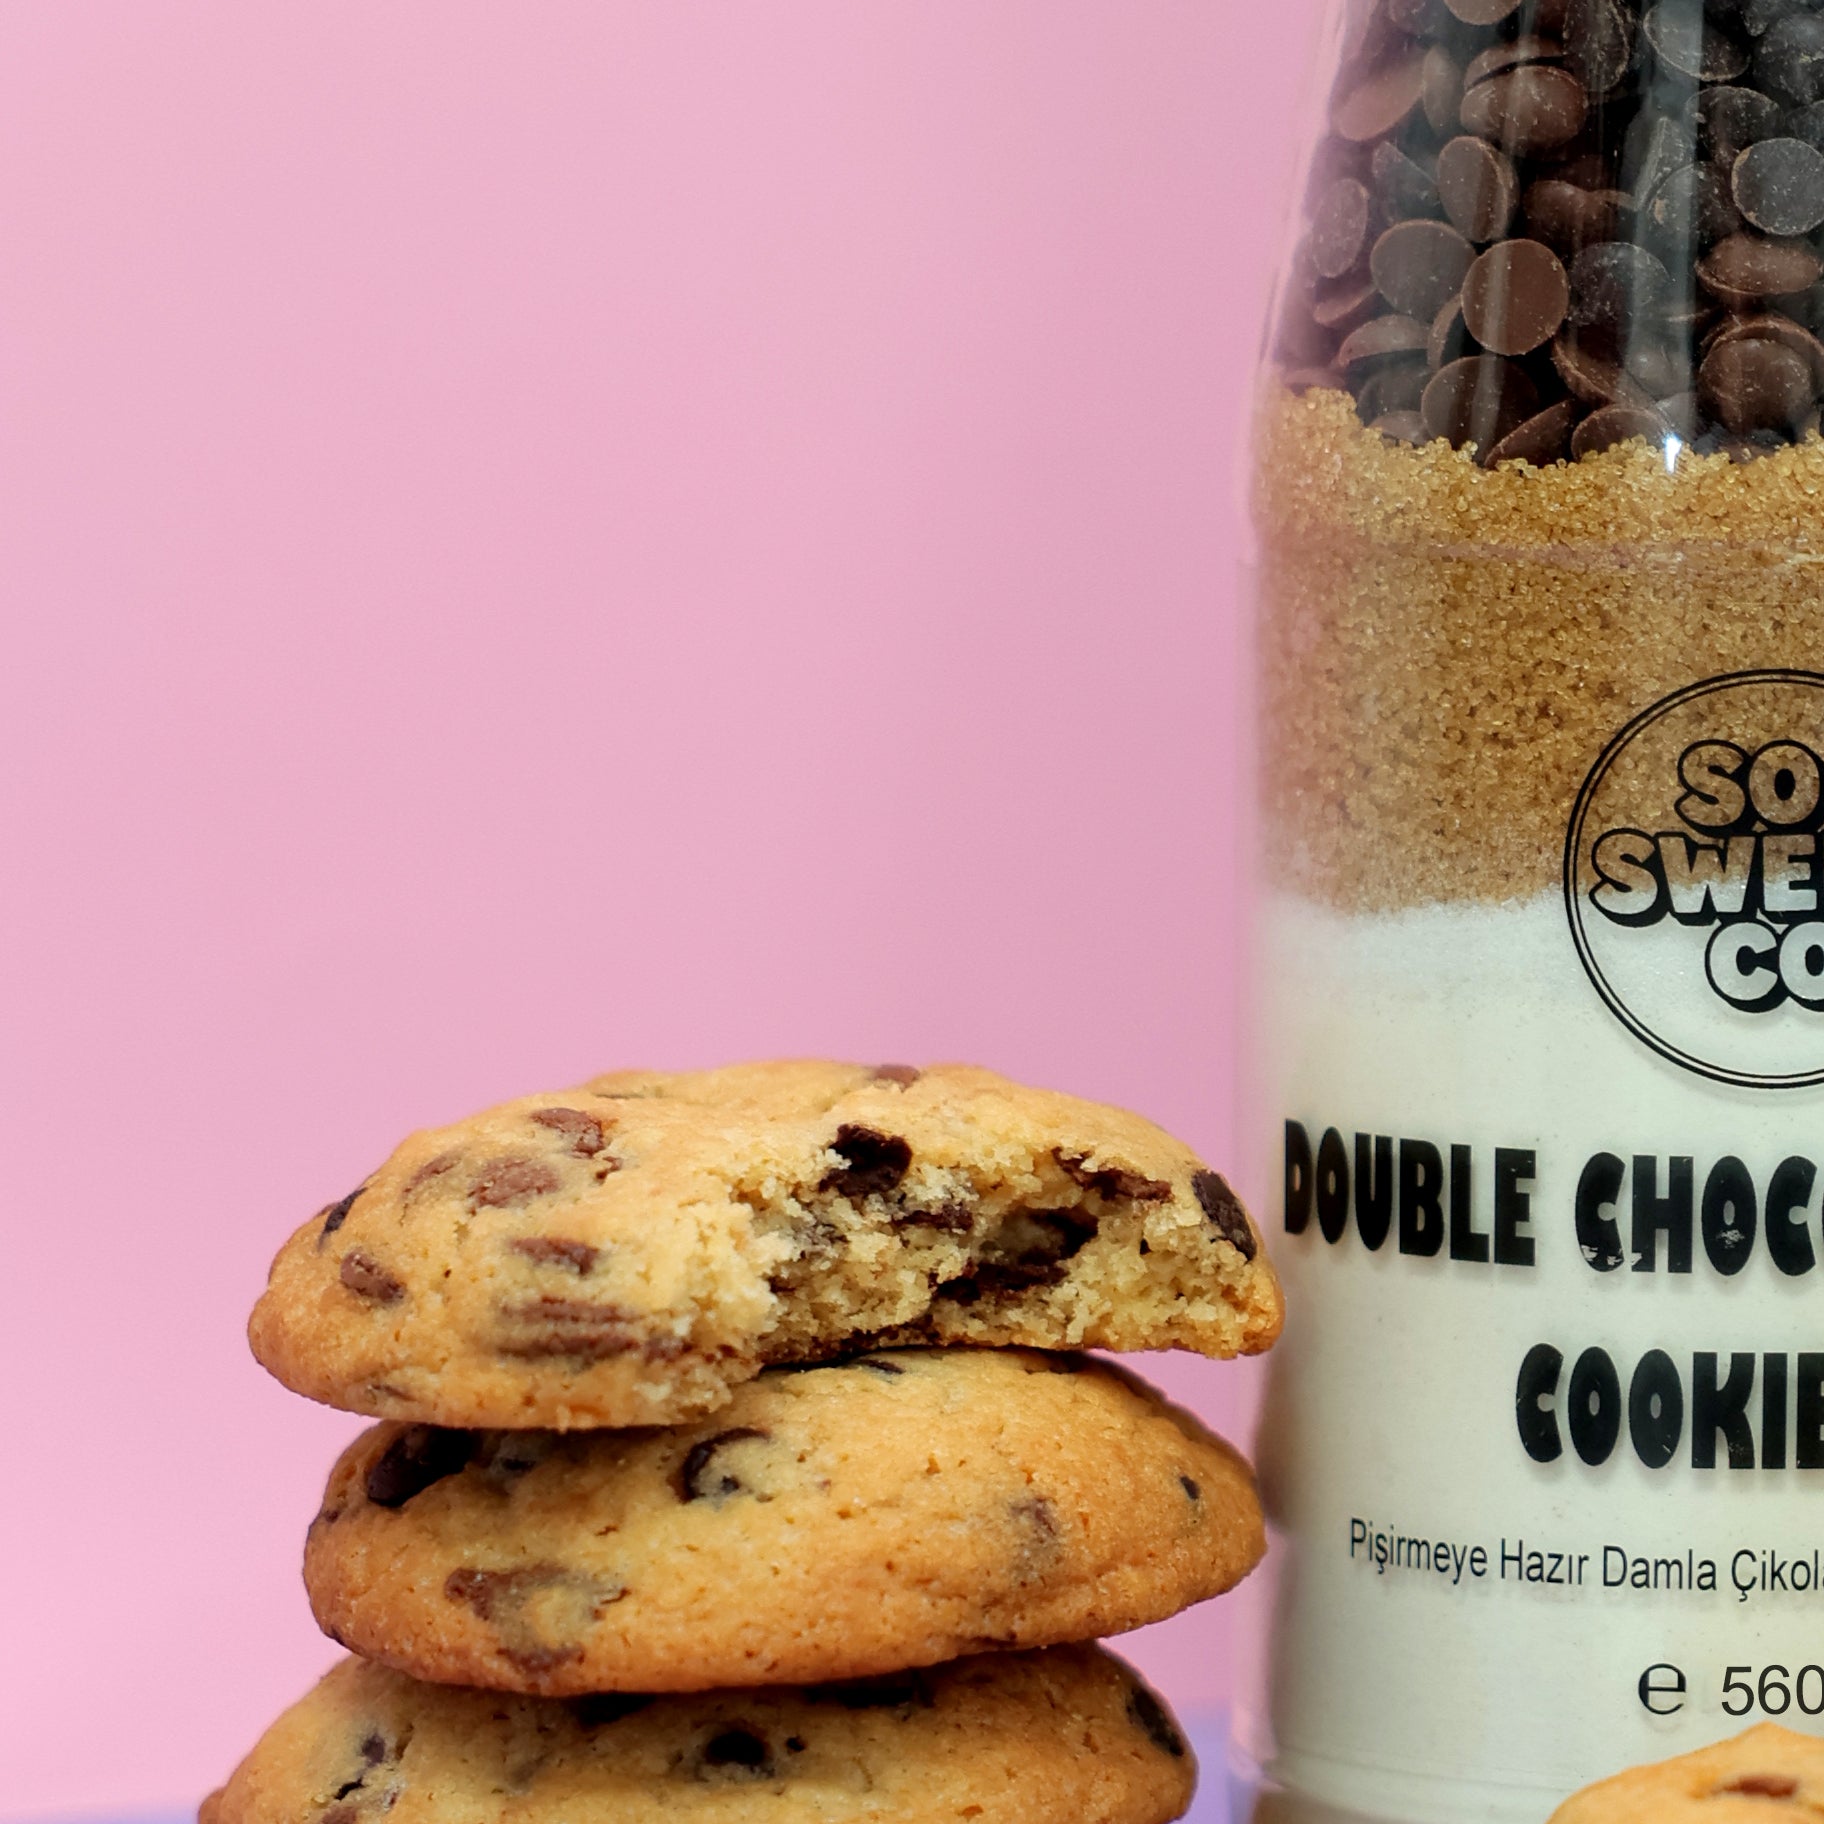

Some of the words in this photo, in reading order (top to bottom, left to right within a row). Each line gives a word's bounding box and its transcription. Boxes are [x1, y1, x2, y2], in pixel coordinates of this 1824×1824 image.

[1283, 1117, 1537, 1267] DOUBLE
[1349, 1516, 1489, 1586] Pişirmeye
[1499, 1537, 1590, 1586] Hazır
[1602, 1544, 1718, 1592] Damla
